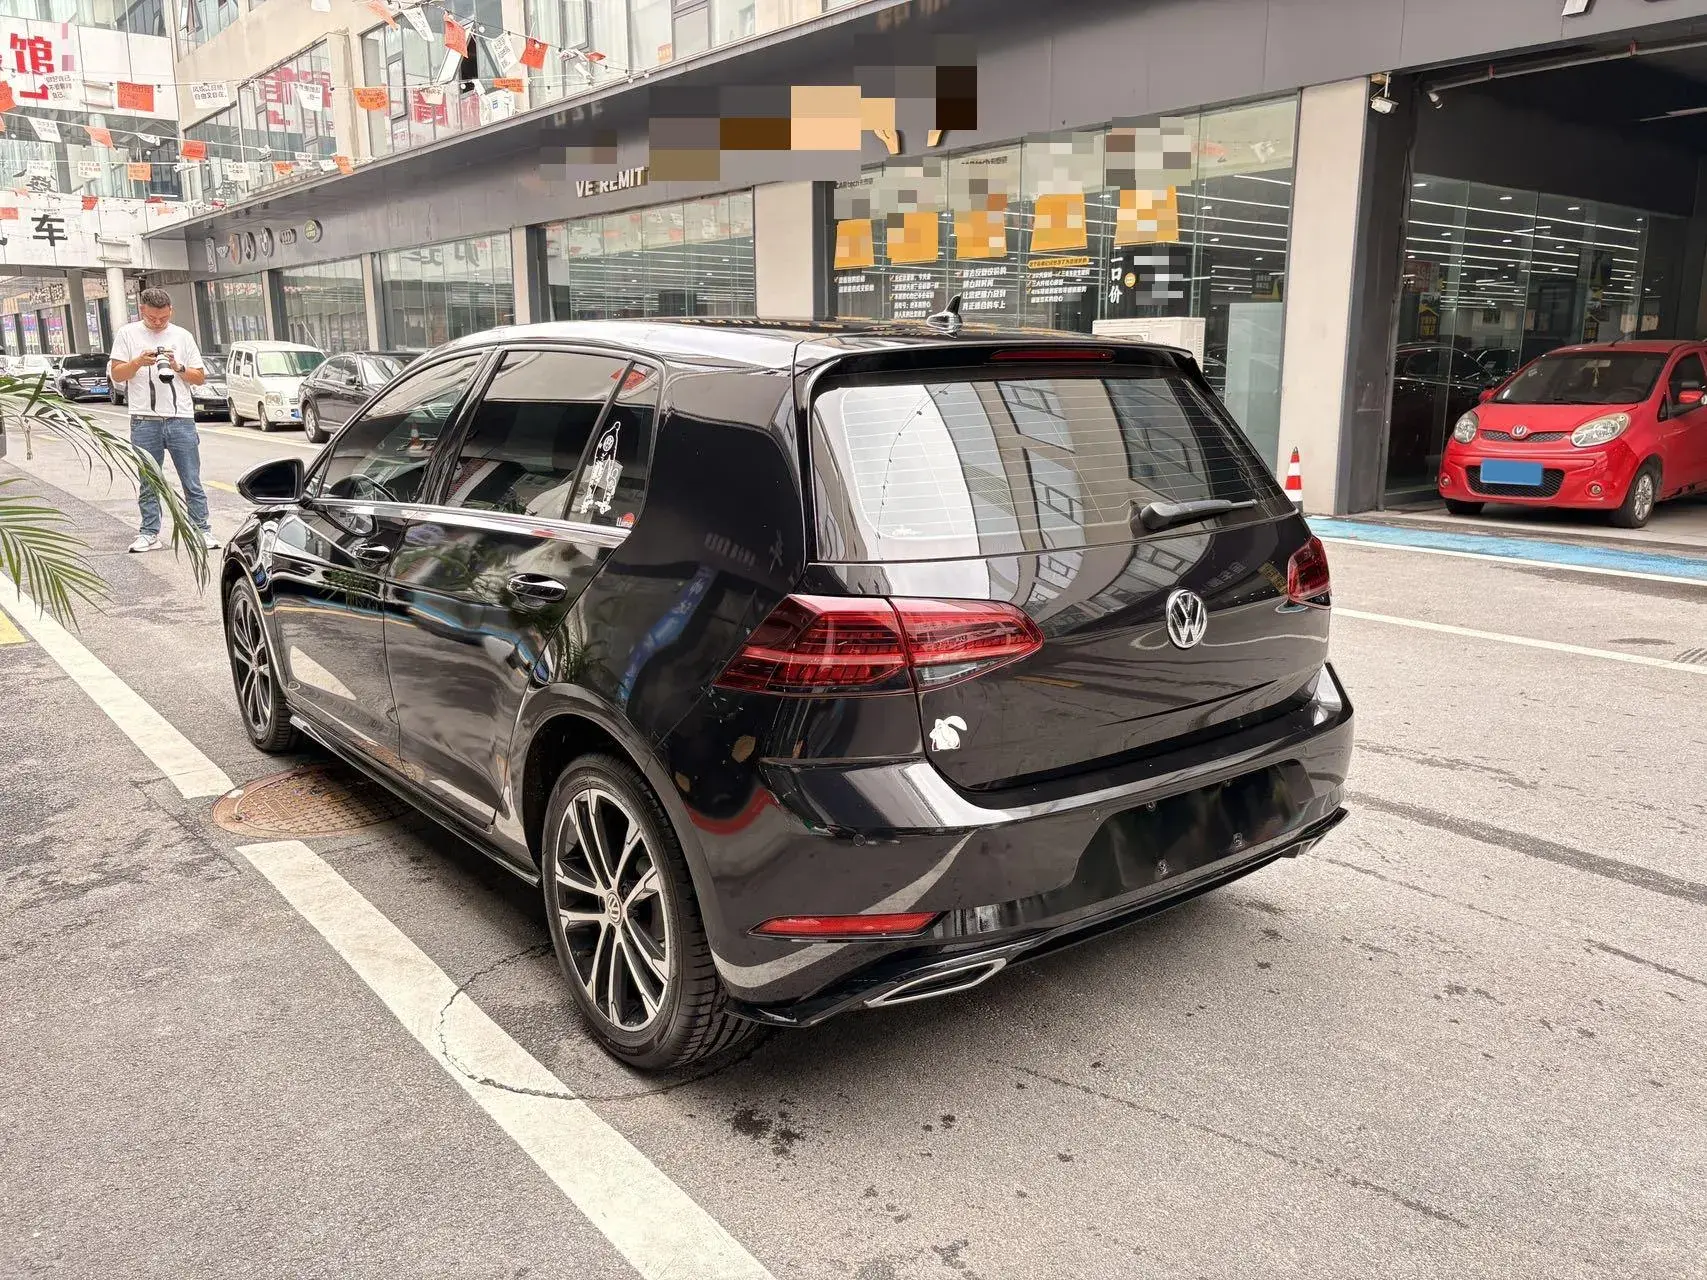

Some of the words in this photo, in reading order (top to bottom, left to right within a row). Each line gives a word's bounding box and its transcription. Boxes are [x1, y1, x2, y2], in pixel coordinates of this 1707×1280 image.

[10, 33, 55, 74] 馆
[31, 213, 68, 247] 车
[1107, 255, 1124, 305] 一口价
